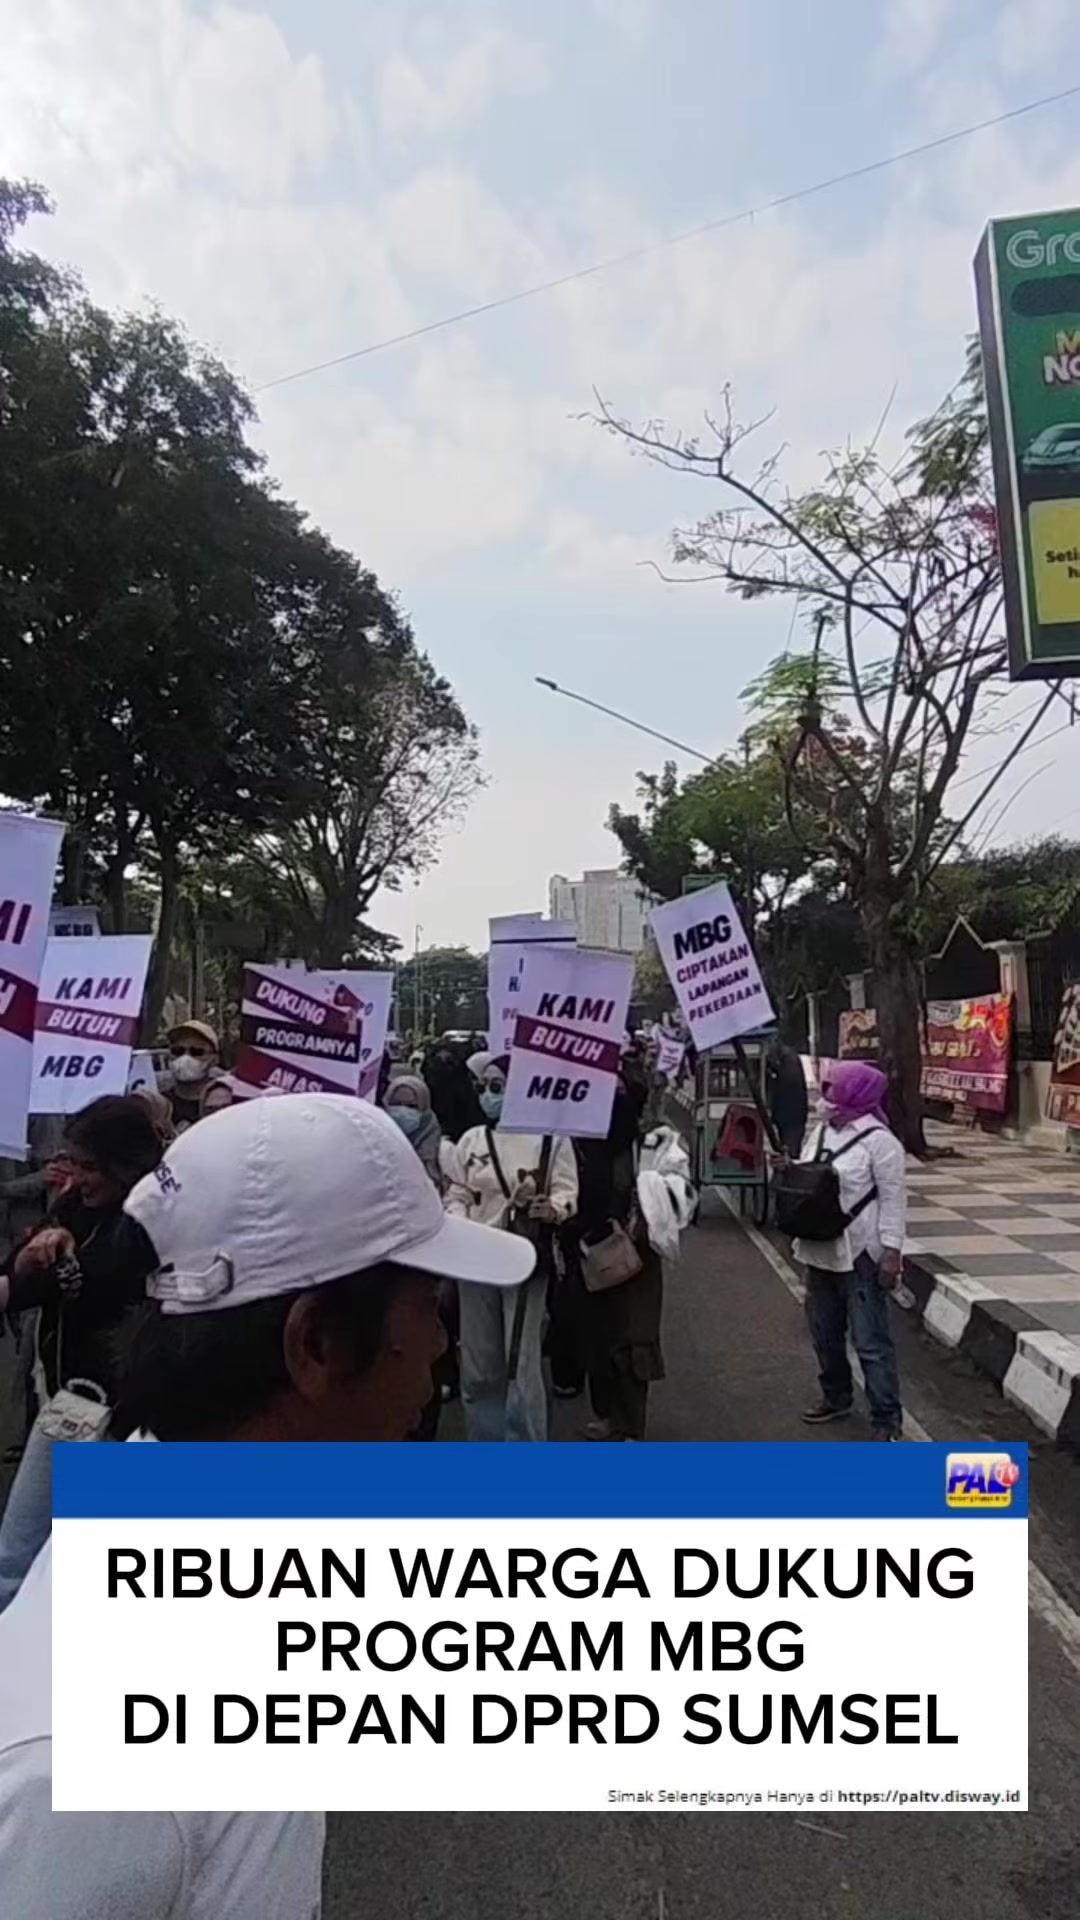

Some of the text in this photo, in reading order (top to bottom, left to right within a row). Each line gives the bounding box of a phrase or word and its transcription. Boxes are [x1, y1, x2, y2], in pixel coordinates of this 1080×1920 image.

[673, 914, 732, 961] MBG
[676, 943, 750, 984] CIPTAKAN
[55, 977, 132, 1000] KAMI
[687, 967, 750, 1002] LAPANGAN
[256, 980, 326, 1025] DUKUNG
[536, 992, 615, 1024] KAMI
[688, 982, 762, 1022] PEKERJAAN
[47, 1008, 121, 1037] BUTUH
[255, 1027, 356, 1058] PROGRAMNYA
[529, 1026, 605, 1062] BUTUH
[40, 1055, 105, 1077] MBG
[526, 1075, 591, 1103] MBG
